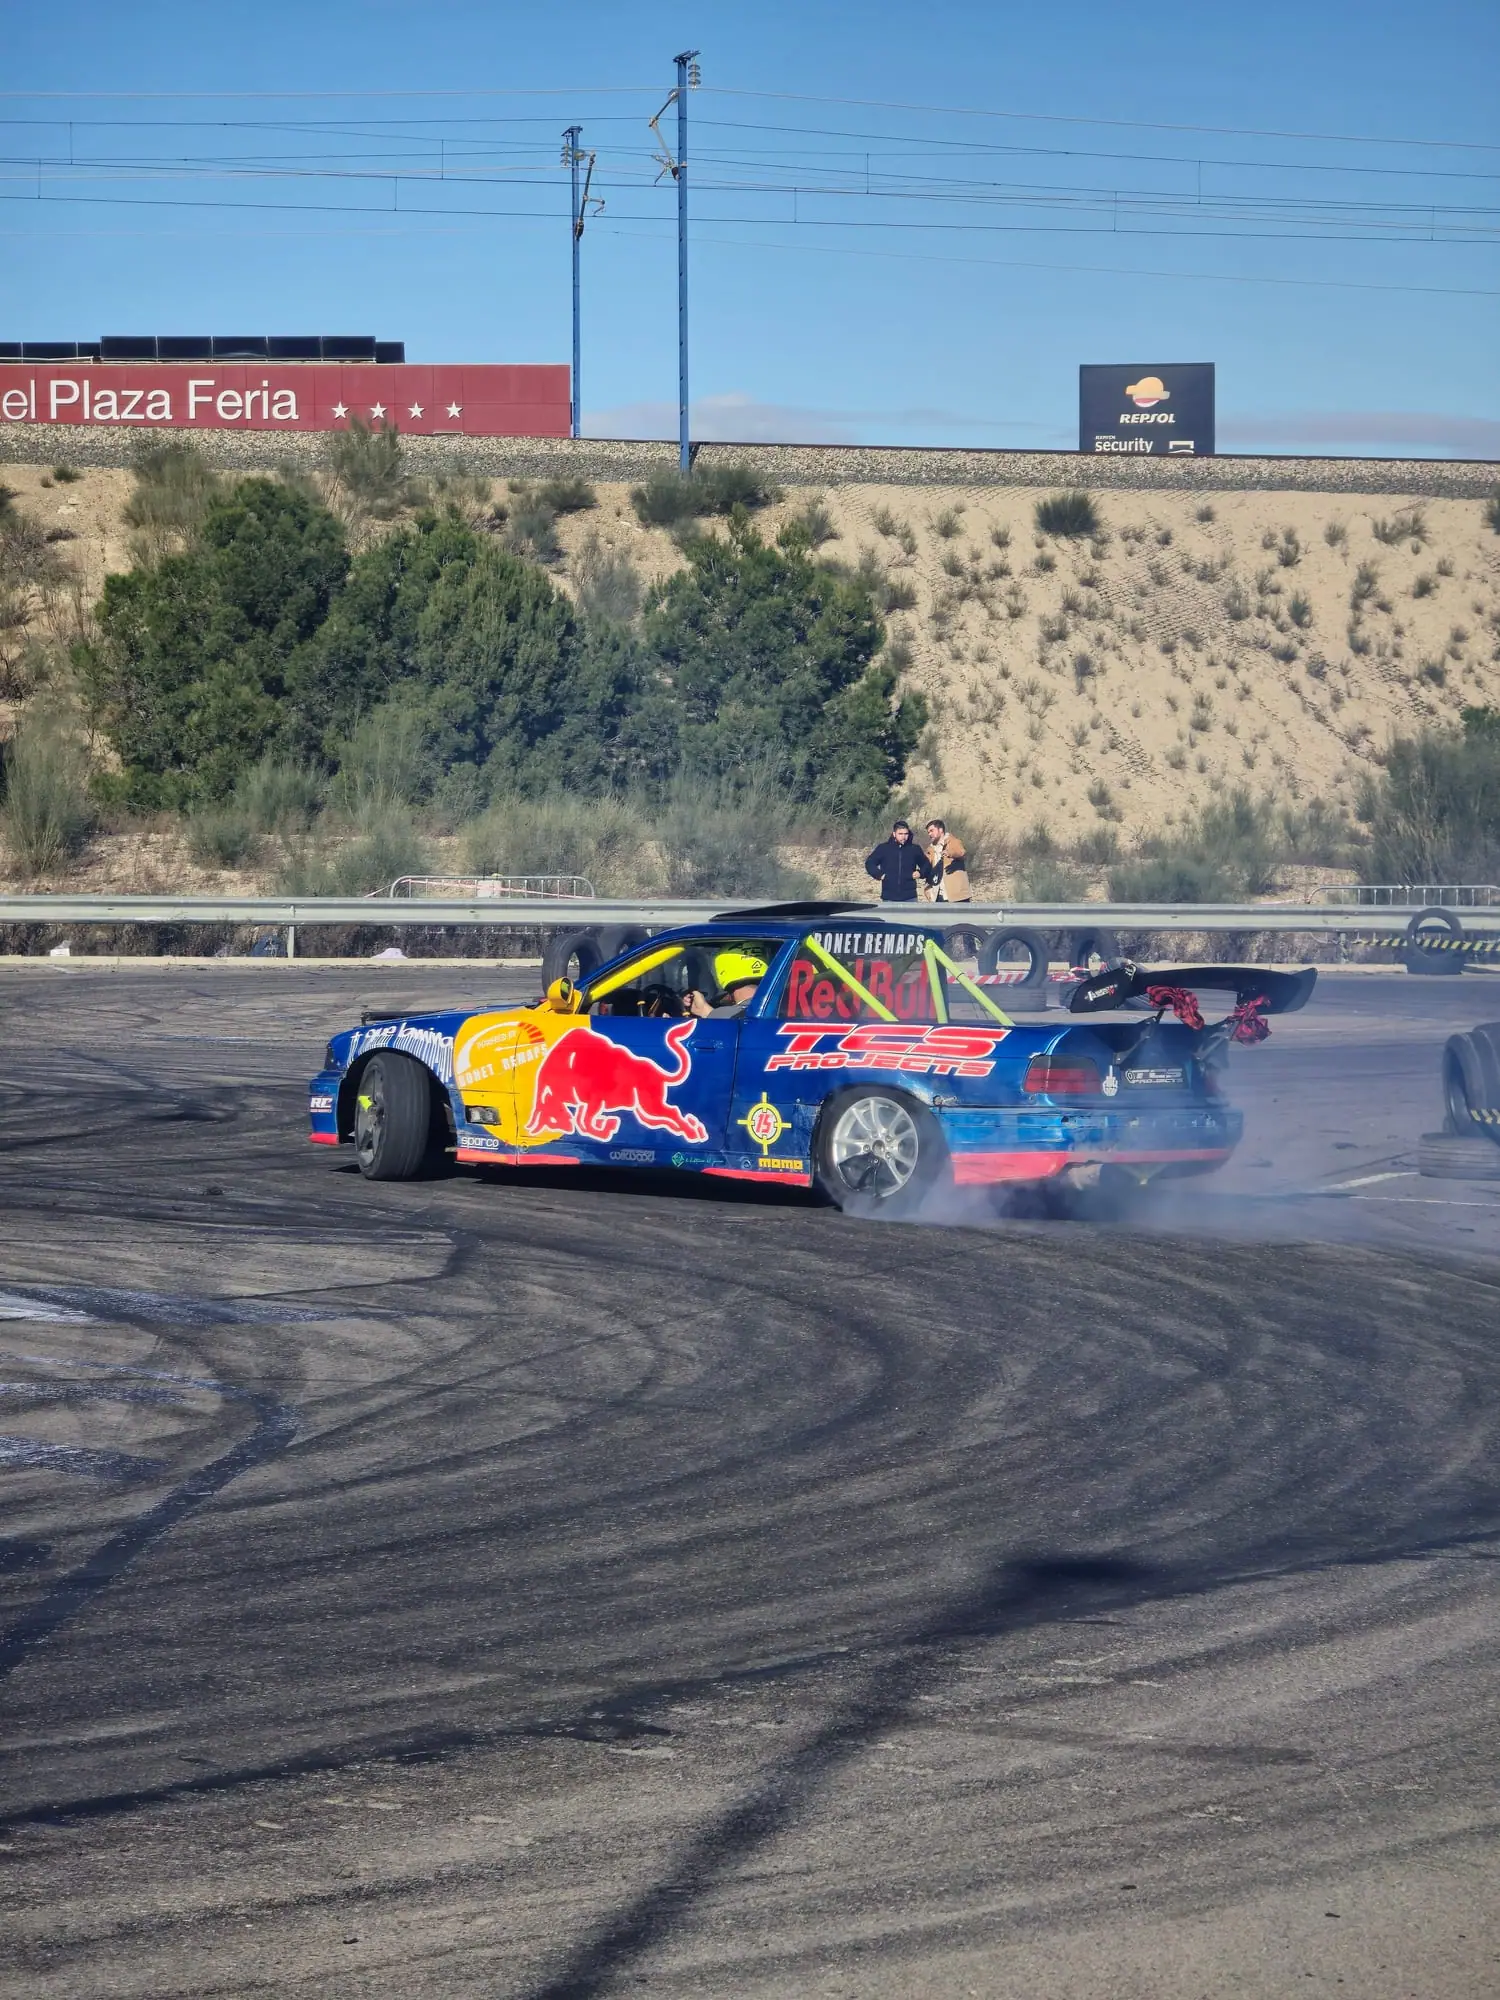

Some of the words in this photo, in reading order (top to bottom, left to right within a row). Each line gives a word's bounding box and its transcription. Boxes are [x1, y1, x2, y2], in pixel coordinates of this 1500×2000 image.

[50, 379, 173, 420] Plaza
[188, 379, 300, 420] Feria
[1120, 413, 1176, 424] REPSOL
[1095, 437, 1154, 453] security
[787, 958, 864, 1019] Red
[777, 1022, 1012, 1060] TCS
[764, 1052, 996, 1077] PROJECTS
[756, 1113, 772, 1134] 15
[461, 1136, 499, 1149] sparco
[758, 1157, 804, 1170] momo
